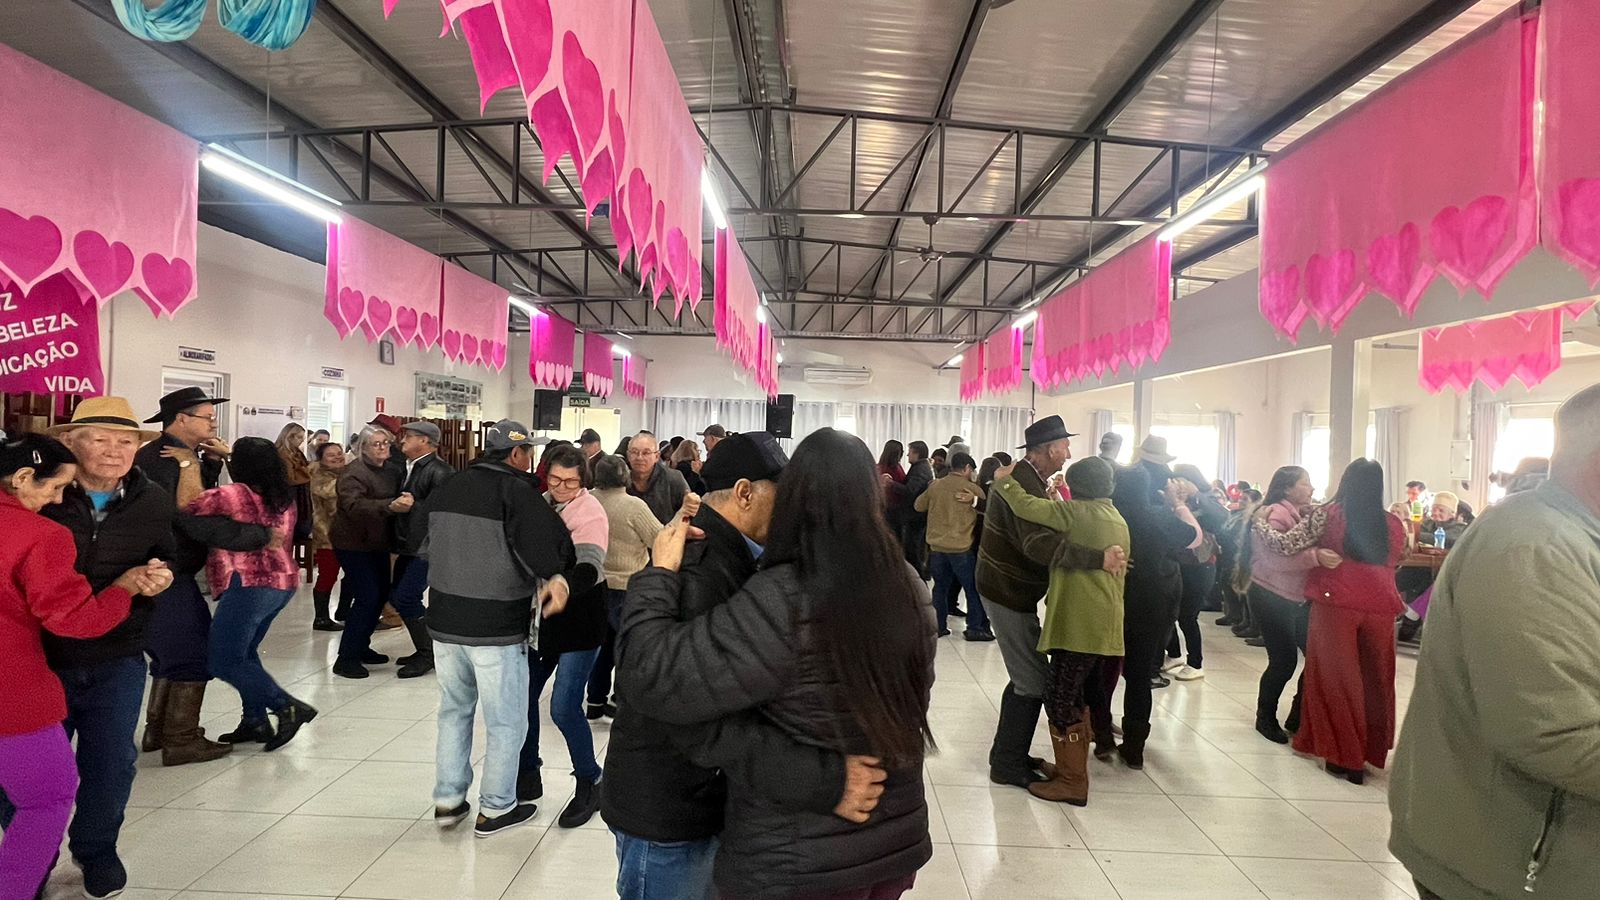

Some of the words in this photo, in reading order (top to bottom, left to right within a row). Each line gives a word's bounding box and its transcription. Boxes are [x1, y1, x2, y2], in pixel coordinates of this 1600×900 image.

[0, 292, 18, 311] Z
[0, 312, 79, 344] BELEZA
[0, 340, 79, 377] ICAÇÃO
[44, 375, 96, 393] VIDA
